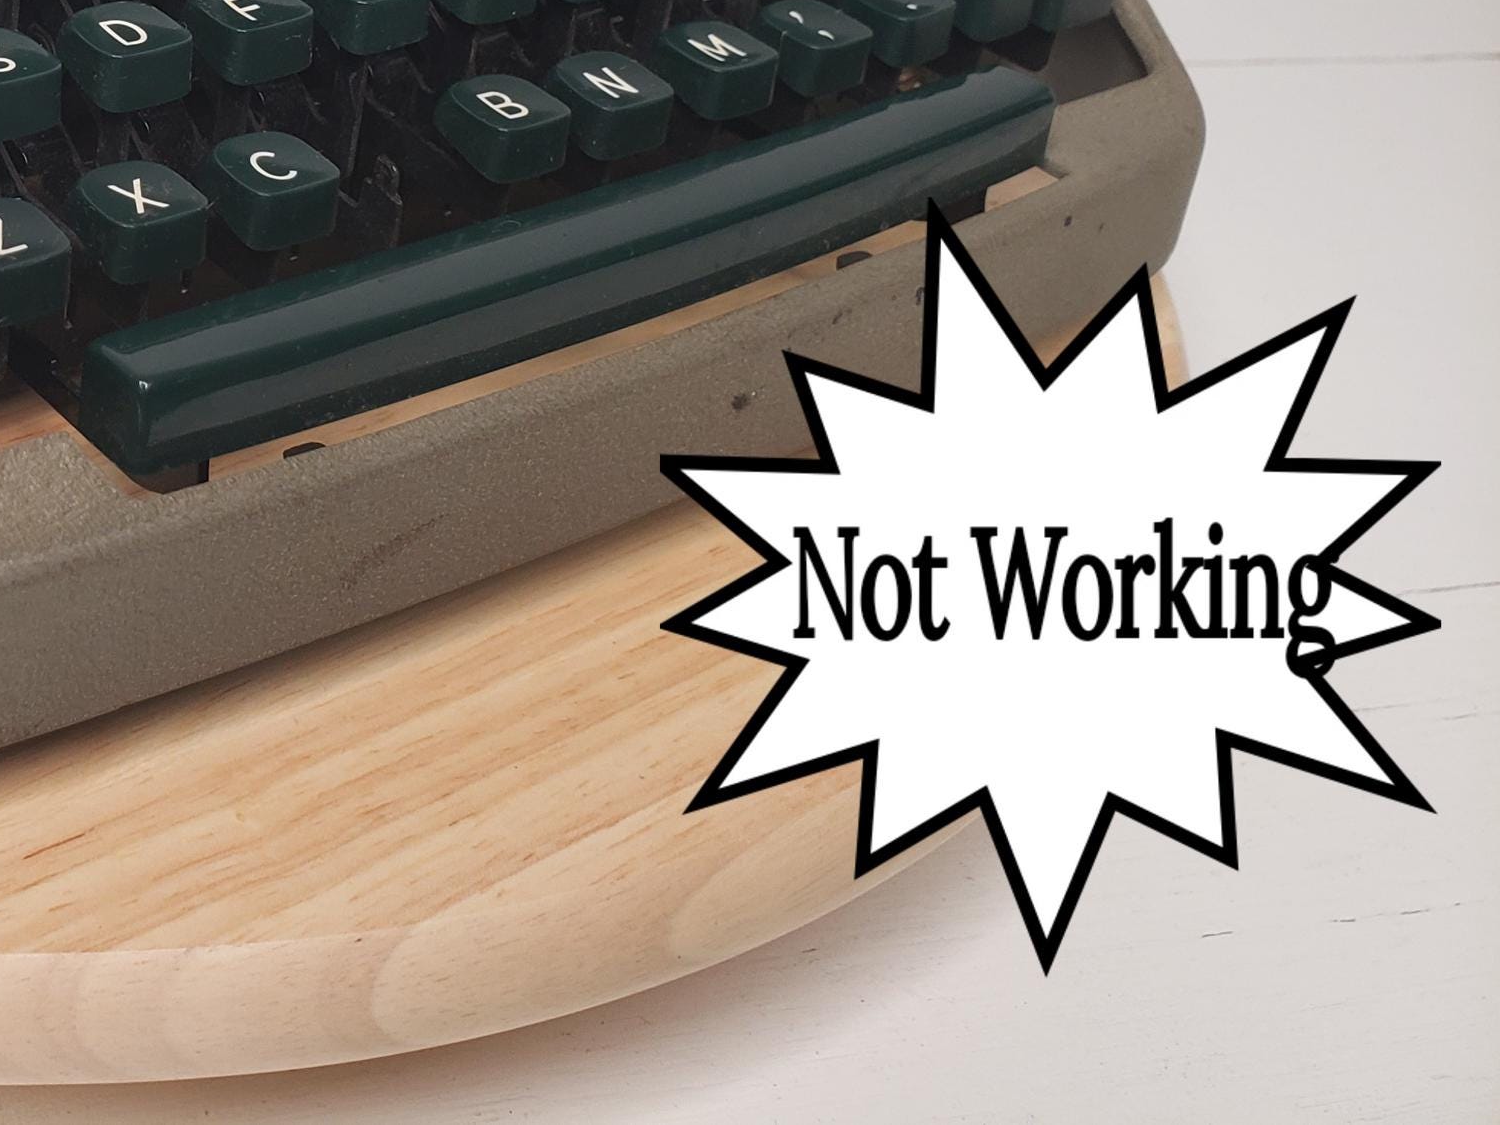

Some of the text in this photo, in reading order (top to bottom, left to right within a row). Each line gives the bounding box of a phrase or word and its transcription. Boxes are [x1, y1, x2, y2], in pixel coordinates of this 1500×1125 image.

[98, 19, 148, 46] D
[687, 33, 747, 62] M
[582, 66, 639, 99] N
[476, 91, 529, 120] B
[249, 151, 298, 181] C
[107, 178, 170, 215] X
